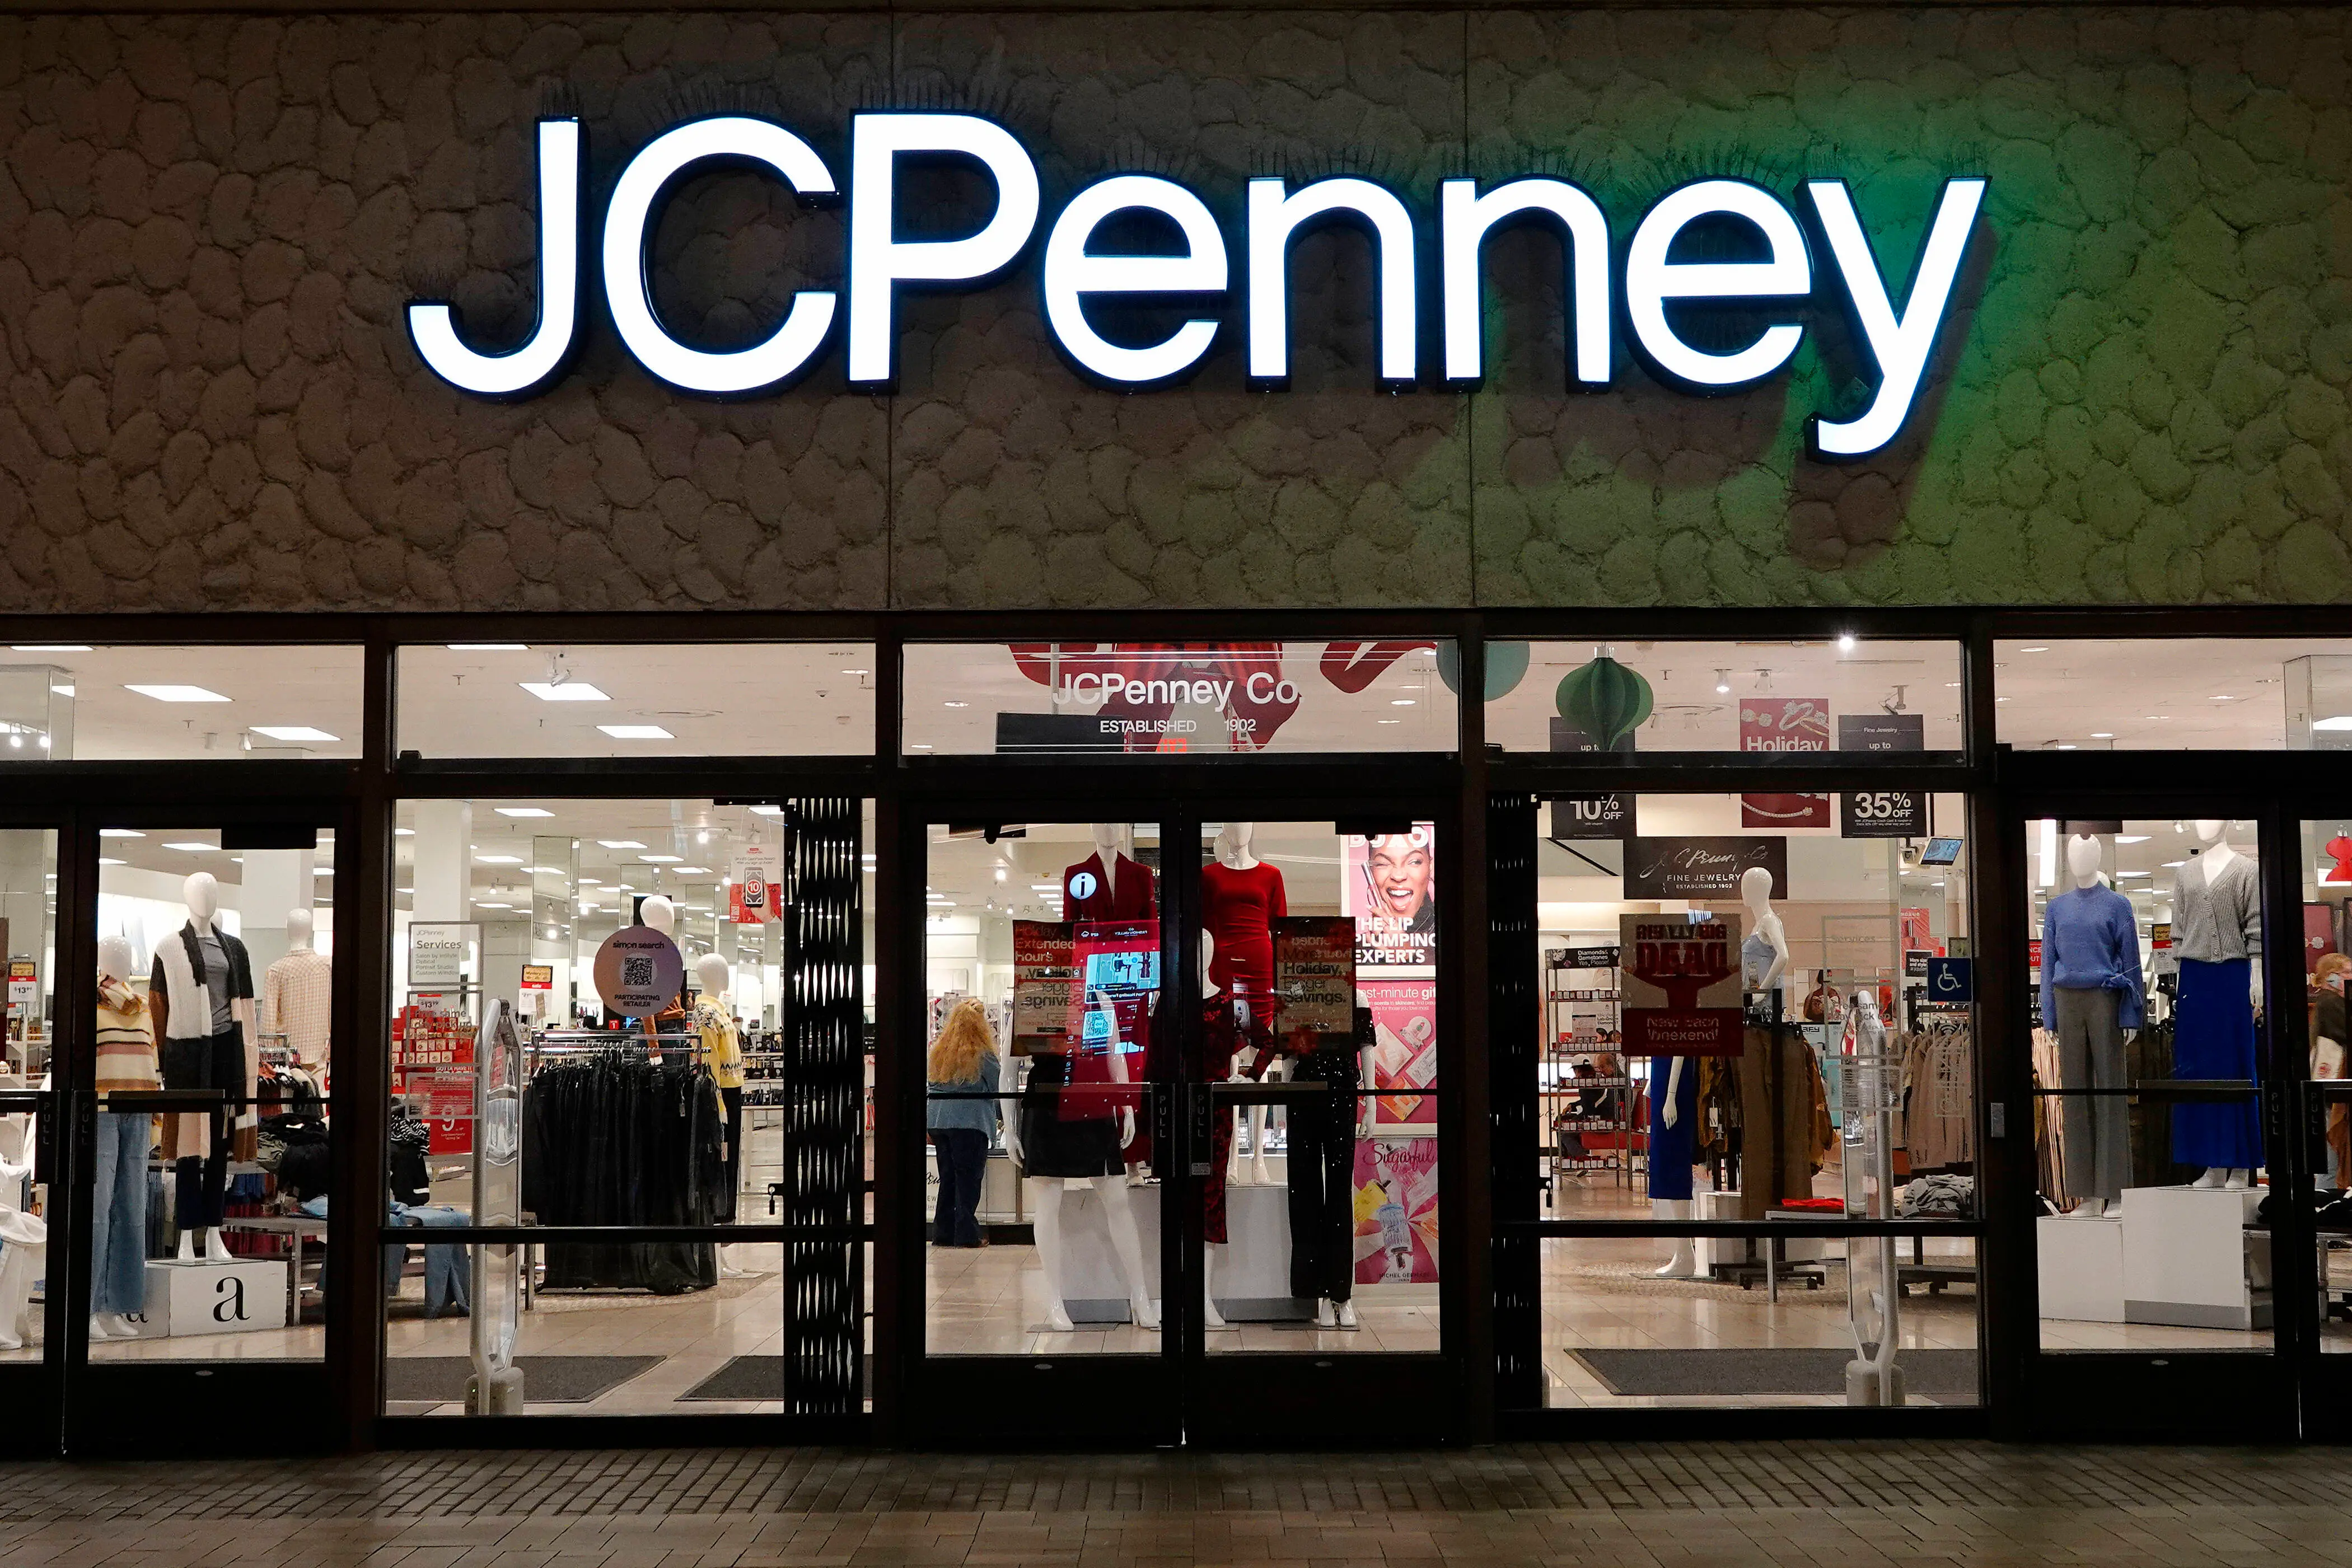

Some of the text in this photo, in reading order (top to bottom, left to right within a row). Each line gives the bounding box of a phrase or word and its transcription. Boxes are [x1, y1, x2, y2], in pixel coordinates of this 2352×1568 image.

[409, 114, 1986, 454] JCPenney
[1053, 672, 1305, 713] JCPenney Co.
[1100, 719, 1256, 733] ESTABLISHED 1902
[1747, 736, 1823, 751] Holiday
[1569, 794, 1619, 820] 10%
[1855, 793, 1911, 818] 35%
[1694, 873, 1741, 882] JEWELRY
[749, 882, 760, 893] 10
[1389, 917, 1414, 931] LIP
[417, 940, 461, 949] Services
[612, 940, 637, 949] simon
[1016, 939, 1076, 949] Extended
[1355, 949, 1425, 963] EXPERTS
[1363, 1139, 1434, 1172] Sugarful
[213, 1276, 250, 1322] a
